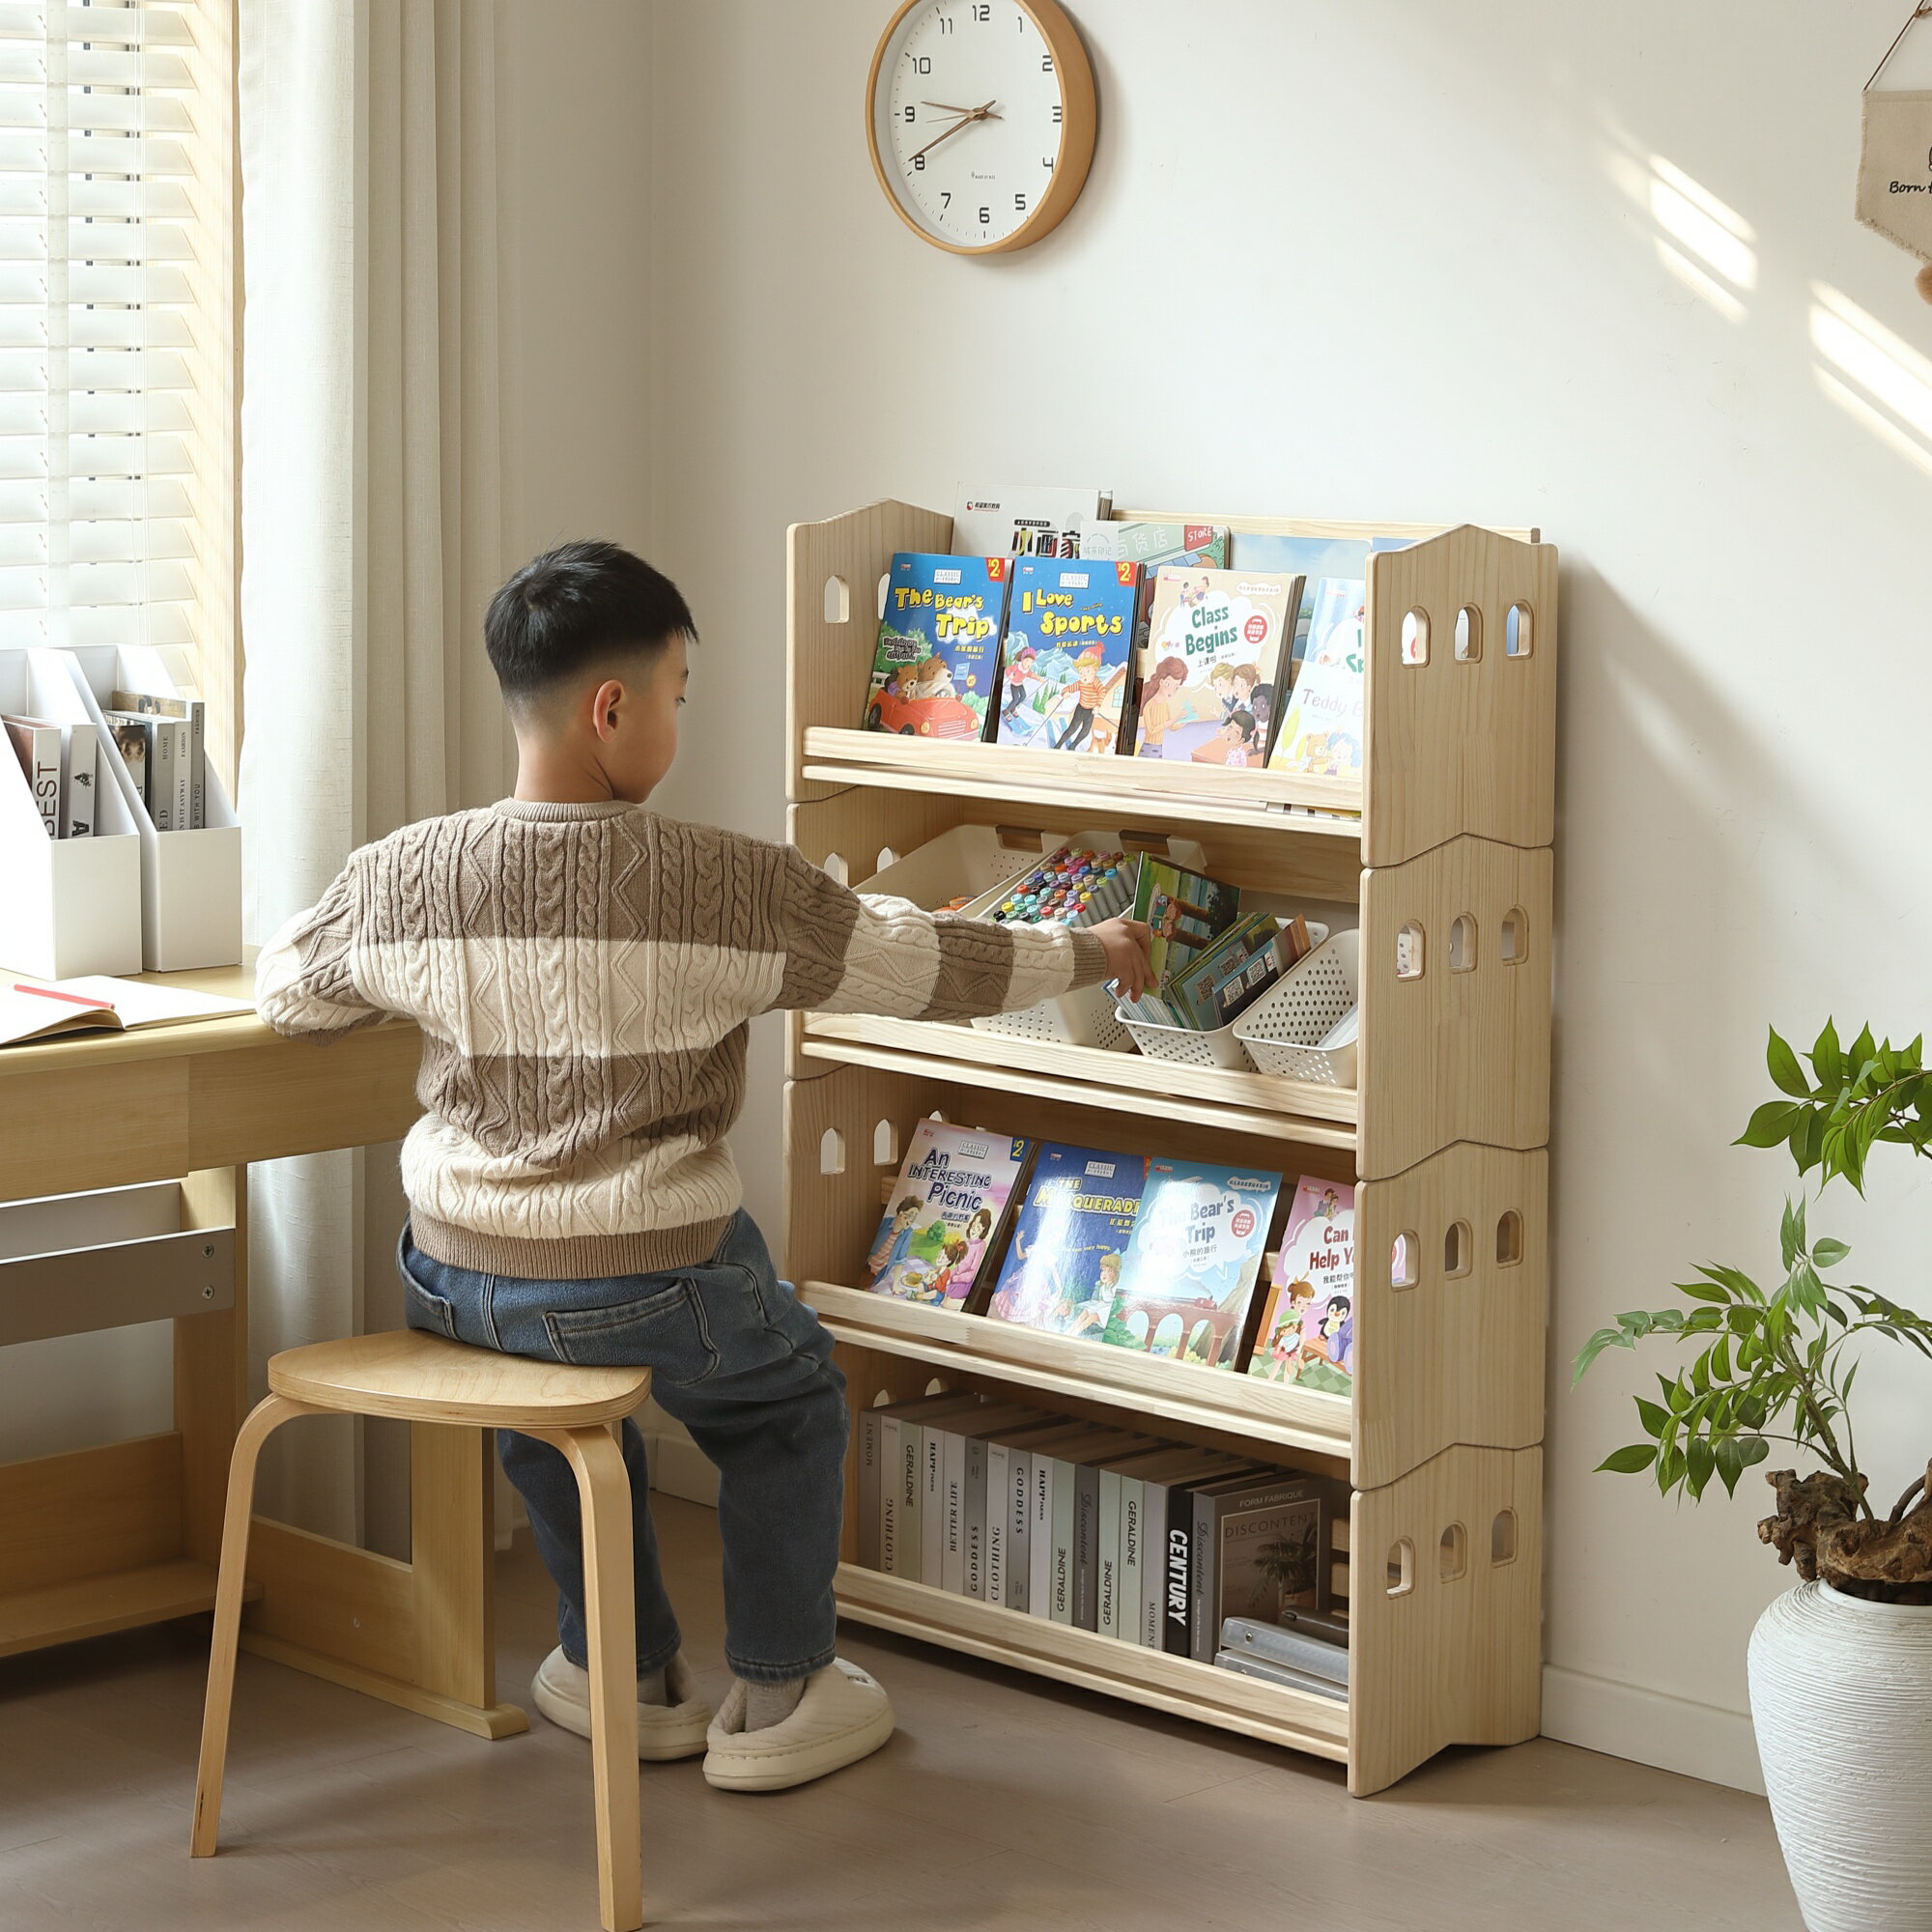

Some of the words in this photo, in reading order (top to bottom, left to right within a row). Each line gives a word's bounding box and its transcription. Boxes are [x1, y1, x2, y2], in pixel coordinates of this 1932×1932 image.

[972, 4, 990, 21] 12
[1017, 15, 1023, 33] 1
[939, 17, 952, 35] 11
[912, 57, 931, 74] 10
[1042, 55, 1053, 71] 2
[904, 106, 916, 123] 9
[1052, 106, 1063, 123] 3
[914, 154, 925, 171] 8
[1042, 156, 1053, 174] 4
[1889, 180, 1926, 194] Born
[940, 192, 952, 209] 7
[1014, 193, 1026, 211] 5
[979, 207, 990, 223] 6
[1187, 526, 1212, 543] STORE
[989, 558, 1001, 578] 2
[1120, 562, 1130, 582] 2
[895, 586, 933, 611] The
[934, 593, 984, 611] Bear's
[1022, 590, 1033, 614] I
[1036, 588, 1073, 609] Love
[935, 613, 990, 641] Trip
[1040, 611, 1123, 639] Sports
[1191, 607, 1230, 629] Class
[1185, 626, 1238, 656] Begins
[1303, 689, 1348, 715] Teddy
[923, 1148, 951, 1169] An
[1011, 1140, 1024, 1157] 2
[907, 1164, 992, 1187] INTERESTING
[1058, 1179, 1082, 1190] THE
[927, 1181, 982, 1211] Picnic
[1034, 1187, 1141, 1216] MQUERAD
[1190, 1195, 1235, 1221] Bear's
[1186, 1222, 1215, 1244] Trip
[1323, 1225, 1350, 1244] Can
[1309, 1248, 1340, 1271] Help
[905, 1444, 914, 1507] GERALDINE
[951, 1480, 959, 1507] LIFE
[1015, 1466, 1024, 1534] GODDESS
[1239, 1496, 1264, 1508] FORM
[1264, 1490, 1304, 1503] FABRIQUE
[885, 1498, 894, 1572] CLOTHING
[949, 1508, 957, 1552] BETTER
[1079, 1492, 1092, 1565] Discontent
[1127, 1500, 1137, 1566] GERALDINE
[1225, 1513, 1315, 1539] DISCONTENT
[970, 1525, 979, 1592] GODDESS
[990, 1525, 1001, 1601] CLOTHING
[1196, 1520, 1208, 1595] Discontent
[1057, 1547, 1066, 1612] GERALDINE
[1169, 1528, 1188, 1627] CENTURY
[1103, 1559, 1113, 1626] GERALDINE
